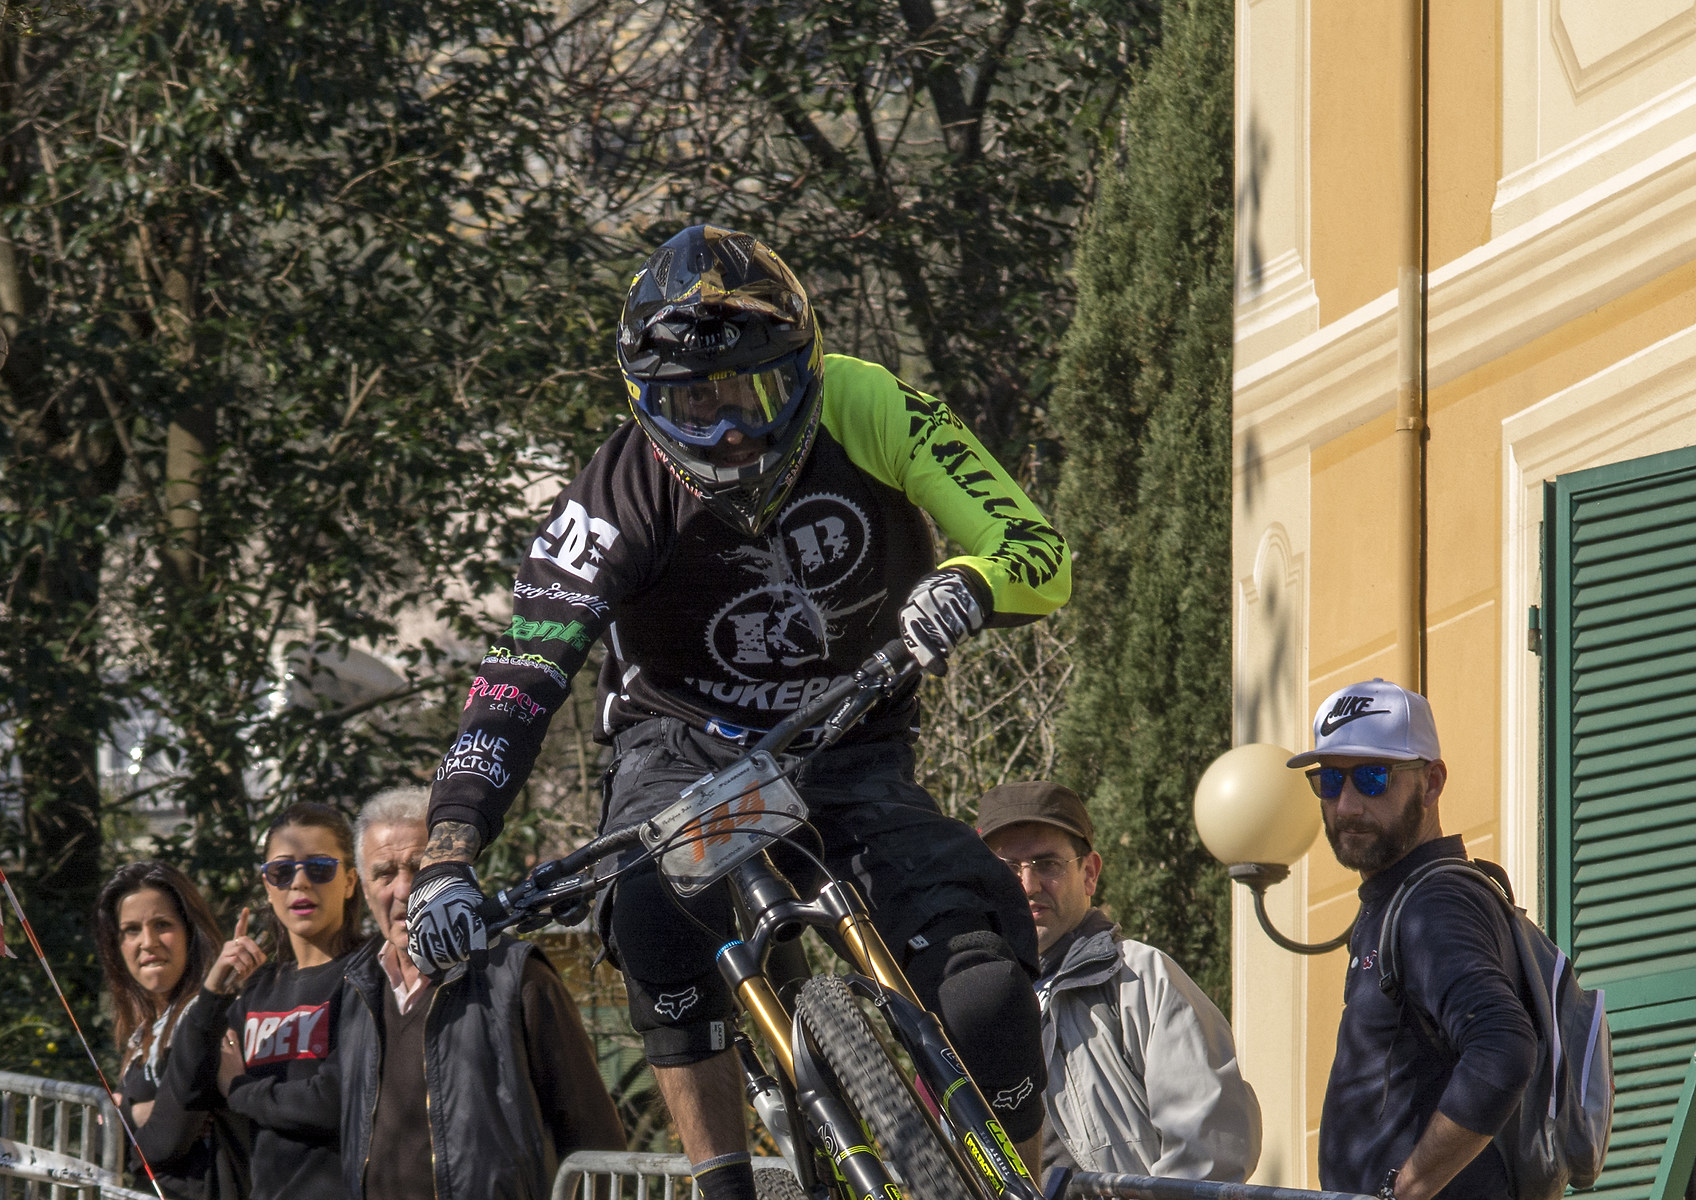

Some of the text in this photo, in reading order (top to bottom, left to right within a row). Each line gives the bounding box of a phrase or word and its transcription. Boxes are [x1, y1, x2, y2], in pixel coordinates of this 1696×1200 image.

[1328, 696, 1375, 718] NIKE
[454, 729, 510, 762] BLUE
[445, 756, 511, 785] FACTORY
[244, 1008, 325, 1063] OBEY
